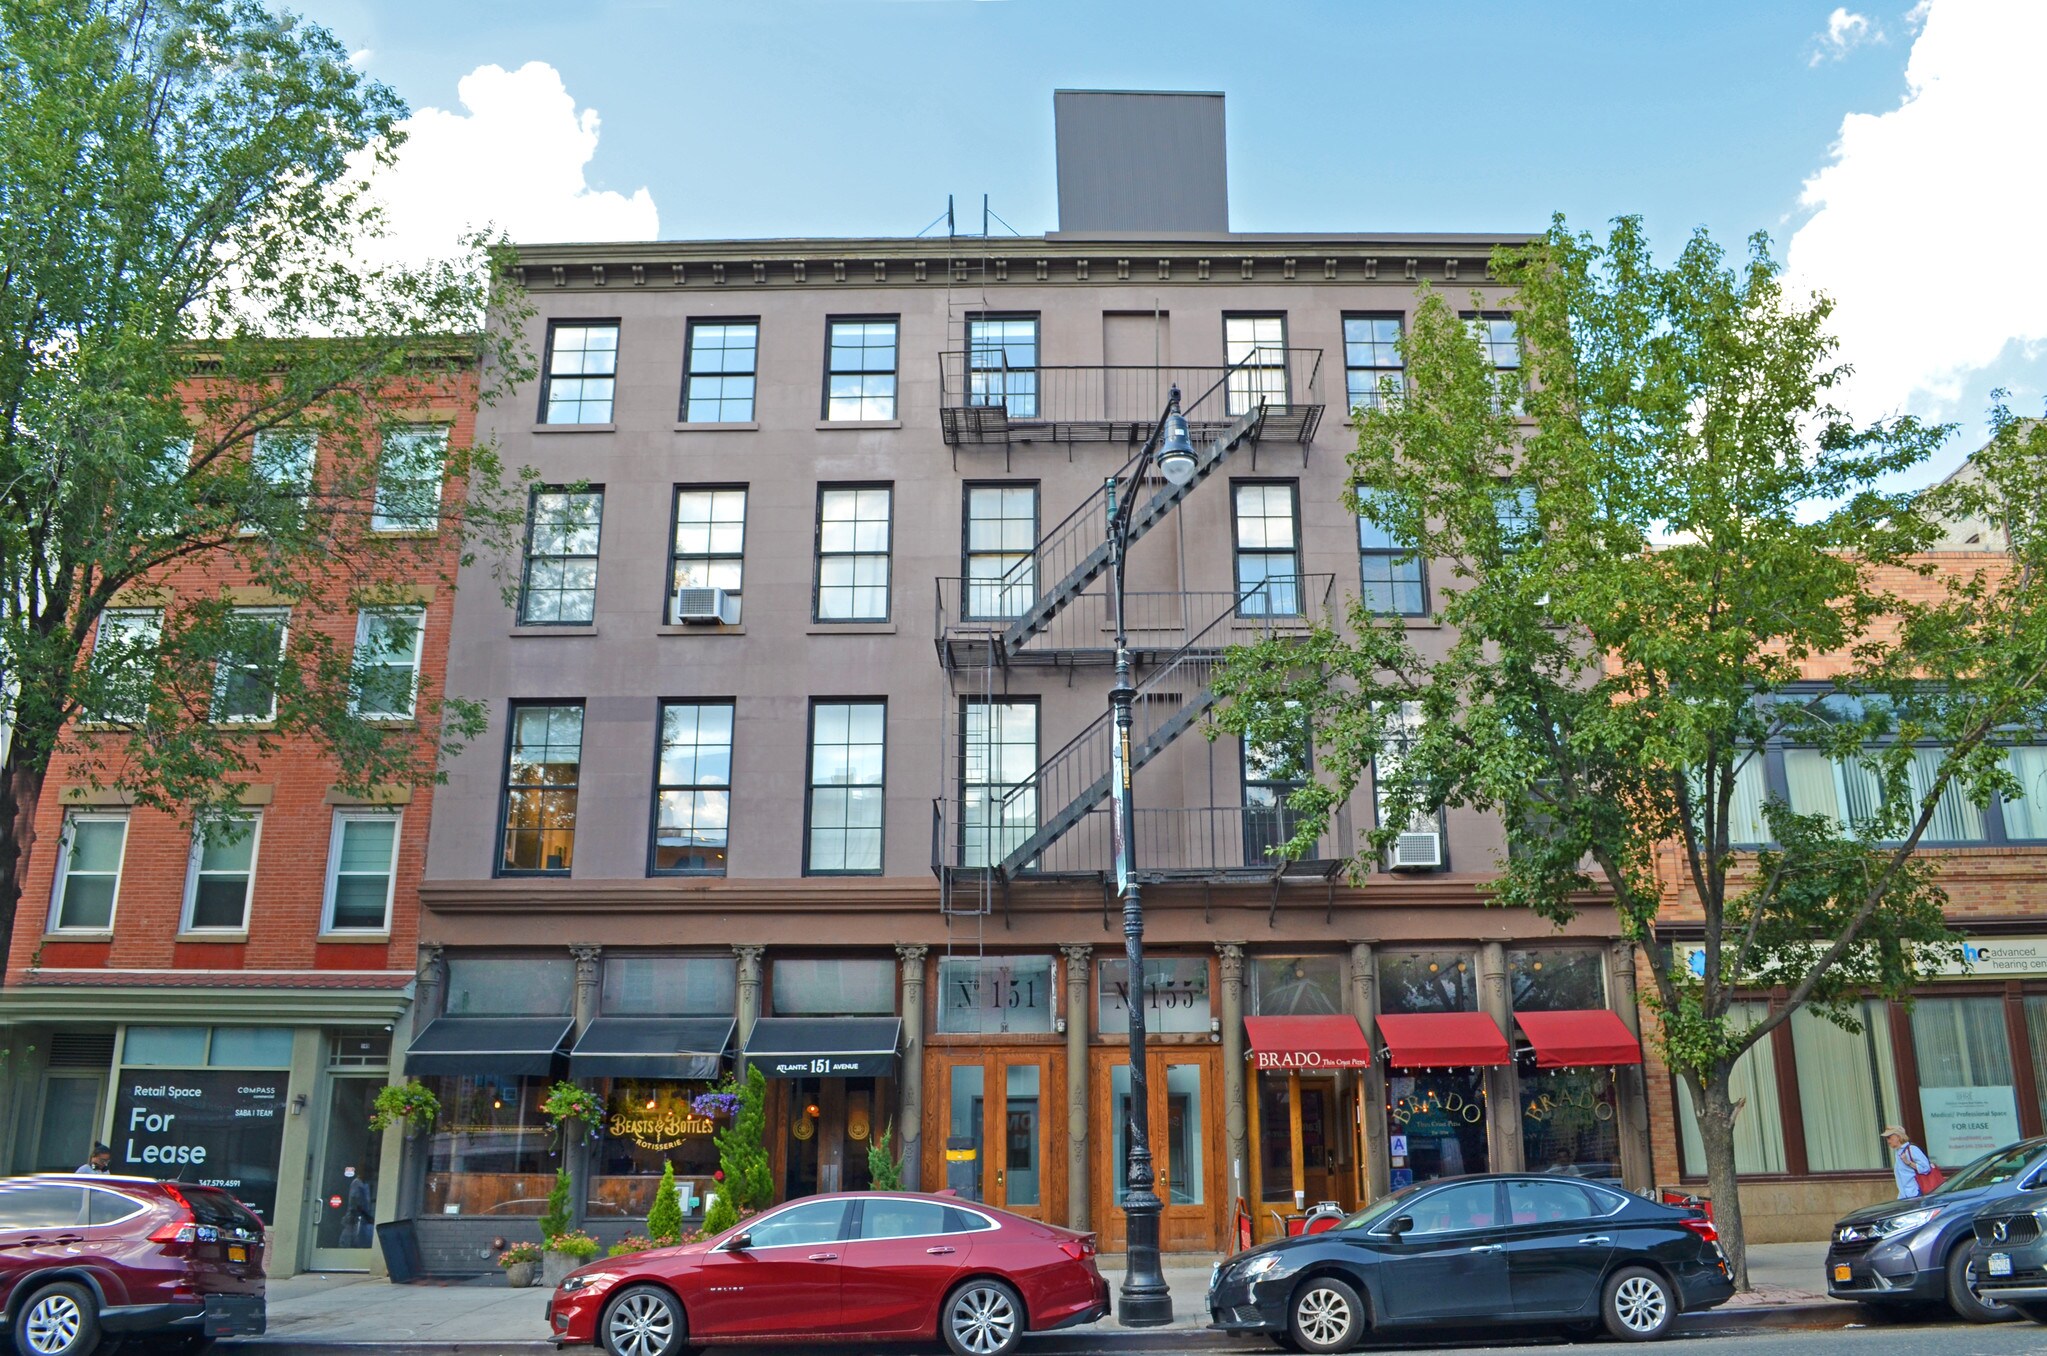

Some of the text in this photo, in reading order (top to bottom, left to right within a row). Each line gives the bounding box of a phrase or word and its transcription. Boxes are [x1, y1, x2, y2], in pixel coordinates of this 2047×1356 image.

[1991, 948, 2036, 957] advanced
[1993, 960, 2028, 971] hearing
[992, 980, 1036, 1008] 151
[1150, 981, 1194, 1009] 155
[776, 1064, 807, 1073] ATLANTIC
[810, 1059, 830, 1073] 151
[1259, 1051, 1320, 1067] BRADO
[134, 1085, 202, 1099] Retail Space
[237, 1086, 275, 1094] COMPASS
[1392, 1092, 1481, 1125] BRADO
[1525, 1088, 1613, 1122] BRADO
[129, 1107, 175, 1132] For
[235, 1109, 251, 1117] SABA
[256, 1109, 273, 1117] TEAM
[664, 1116, 713, 1136] BOTTLES
[1968, 1122, 1989, 1130] LEASE
[126, 1138, 207, 1164] Lease
[636, 1138, 682, 1151] ROTISSERIE
[1394, 1138, 1404, 1150] A
